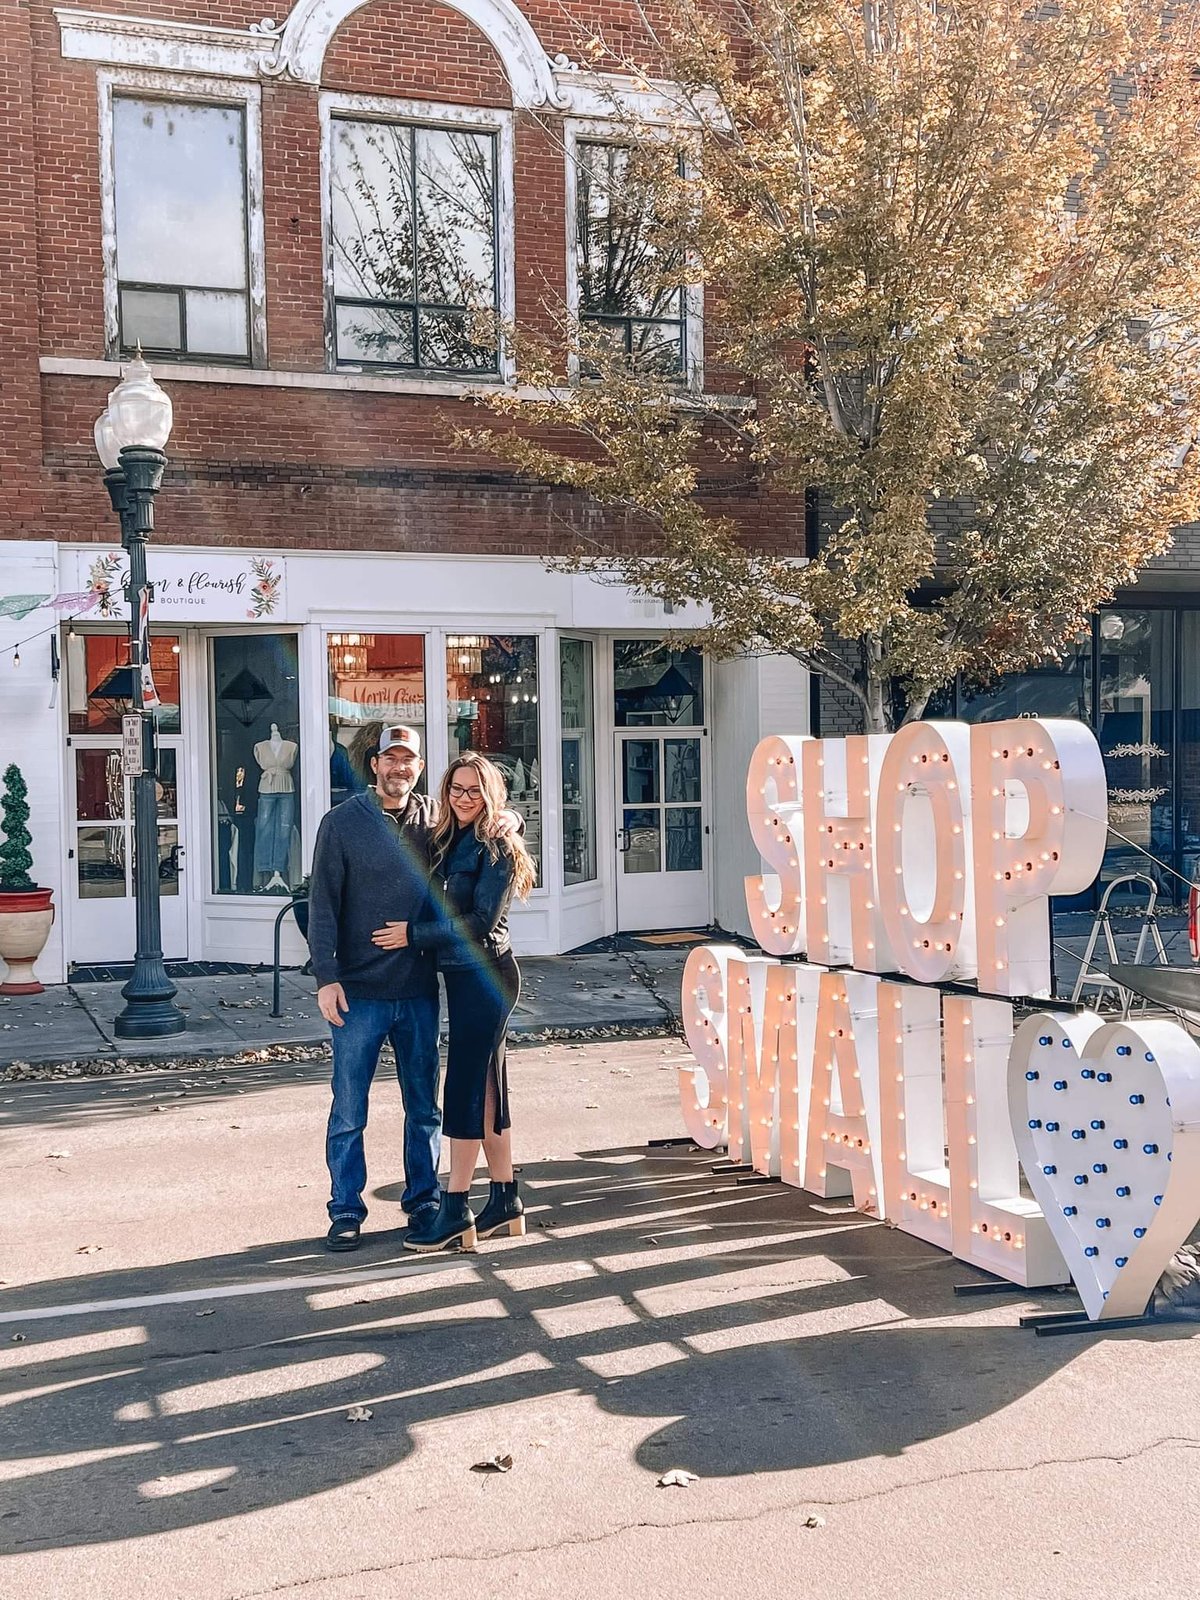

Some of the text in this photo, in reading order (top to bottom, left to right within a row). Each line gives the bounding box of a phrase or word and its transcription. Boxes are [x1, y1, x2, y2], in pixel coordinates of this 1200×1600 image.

[160, 597, 206, 605] BOUTIQUE
[188, 571, 247, 594] flourish
[744, 719, 1107, 997] SHOP
[679, 946, 1070, 1287] SMALL
